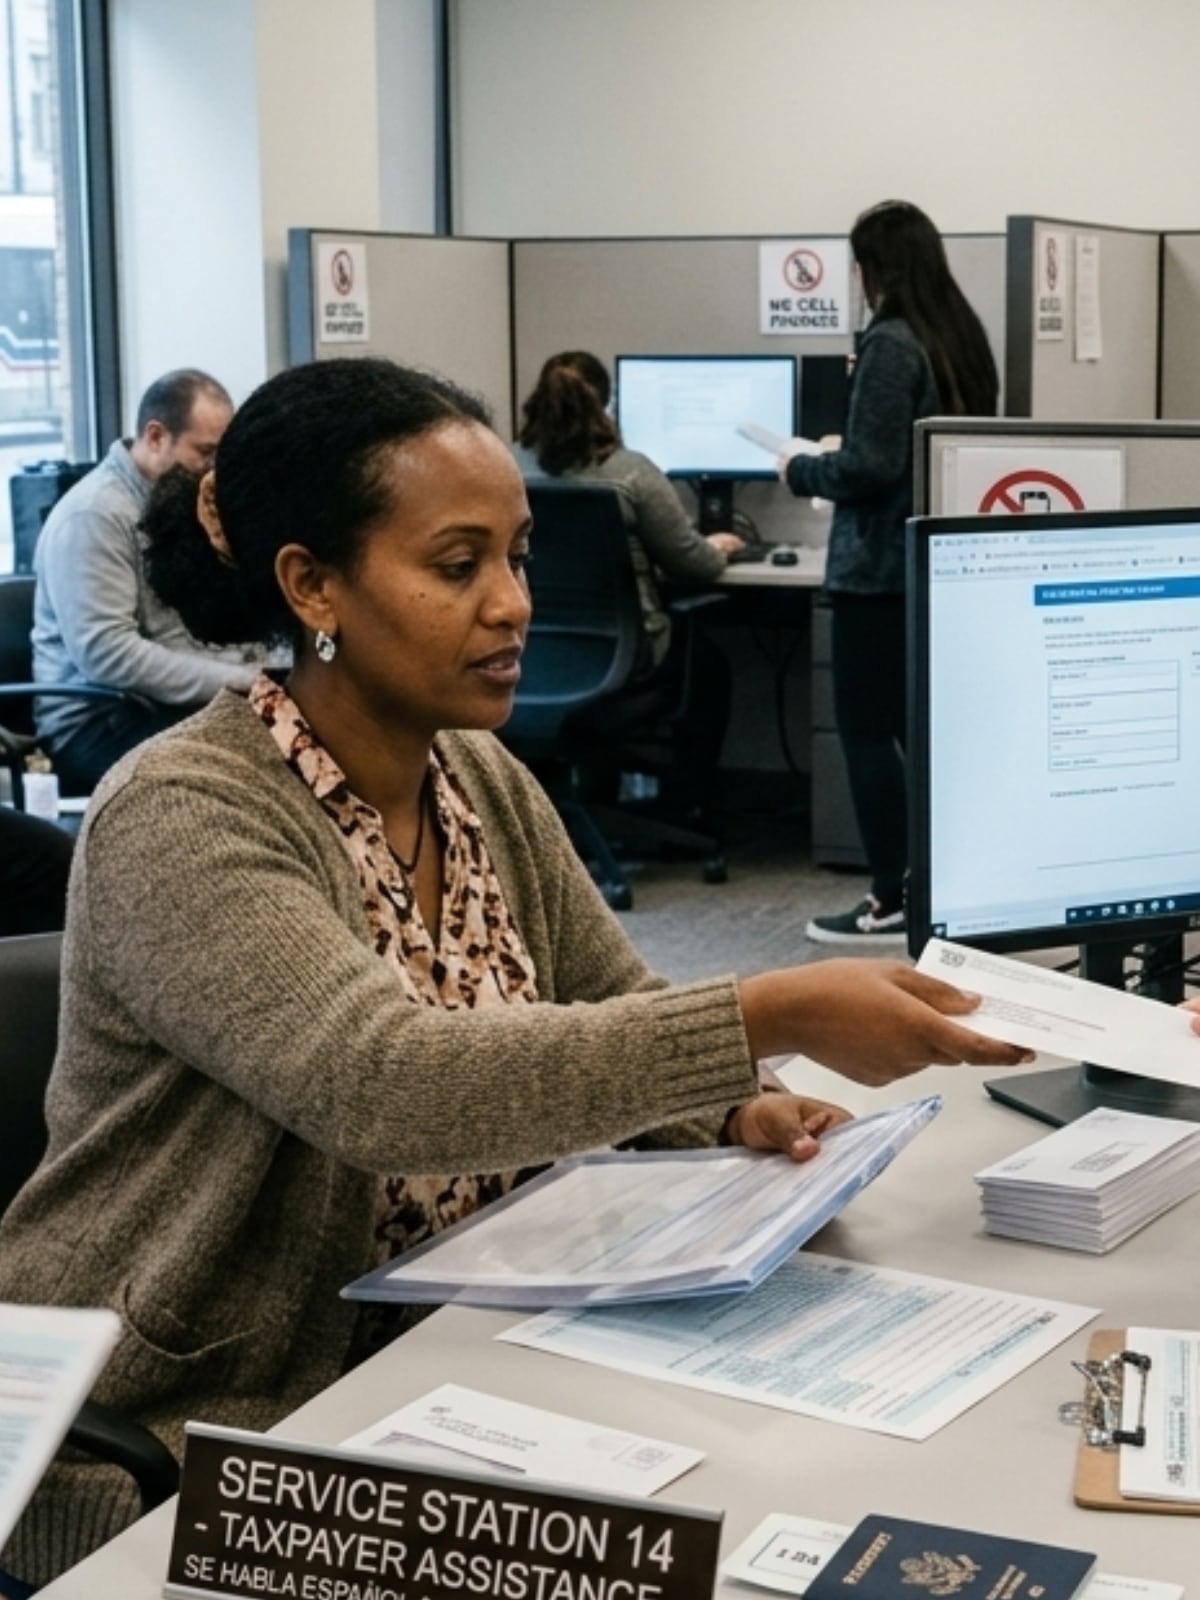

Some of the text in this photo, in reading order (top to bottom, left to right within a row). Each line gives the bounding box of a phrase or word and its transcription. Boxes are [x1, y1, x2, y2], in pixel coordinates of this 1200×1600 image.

[218, 1456, 675, 1573] SERVICE STATION 14
[219, 1511, 408, 1579] TAXPAYER
[184, 1554, 216, 1582] SE
[220, 1561, 297, 1597] HABLA
